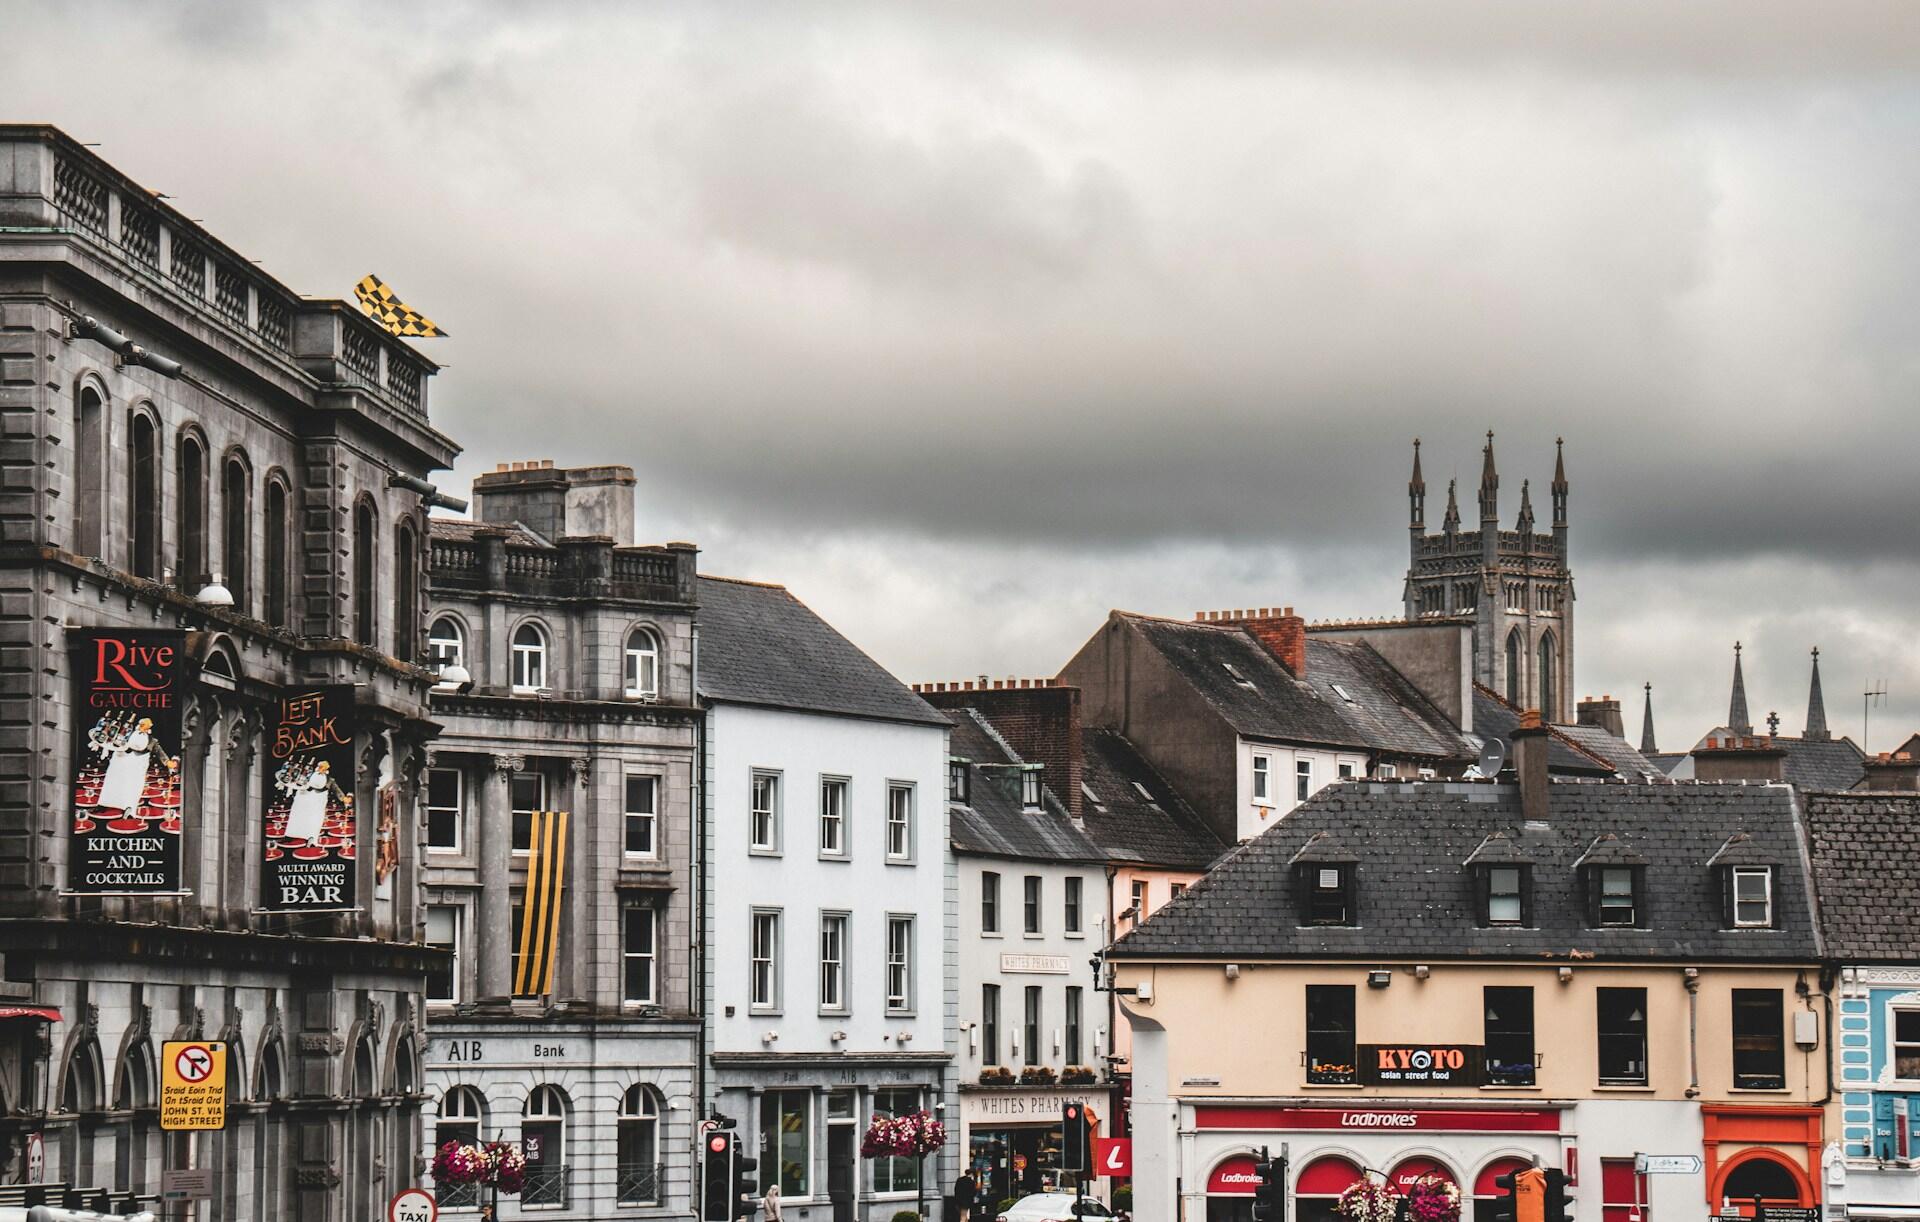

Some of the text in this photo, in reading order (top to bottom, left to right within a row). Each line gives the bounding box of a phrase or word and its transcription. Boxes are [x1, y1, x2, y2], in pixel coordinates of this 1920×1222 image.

[90, 638, 174, 691] Rive
[90, 693, 172, 708] GAUCHE
[280, 696, 325, 725] LEFT
[272, 716, 351, 758] BANK
[87, 838, 164, 851] KITCHEN
[106, 855, 145, 868] AND
[278, 863, 346, 873] MULTI AWARD
[86, 872, 165, 884] COCKTAILS
[278, 874, 345, 886] WINNING
[280, 886, 344, 904] BAR
[448, 1041, 565, 1061] AIB Bank
[1378, 1049, 1464, 1069] KYOTO
[841, 1070, 857, 1083] AIB
[1381, 1071, 1401, 1079] asian
[1432, 1071, 1449, 1080] food
[164, 1107, 222, 1115] JOHN ST. VIA
[982, 1098, 1024, 1113] WHITES
[163, 1117, 222, 1125] HIGH STREET
[1341, 1113, 1418, 1126] Ladbrokes
[526, 1151, 539, 1160] AIB
[400, 1213, 428, 1222] TAXI
